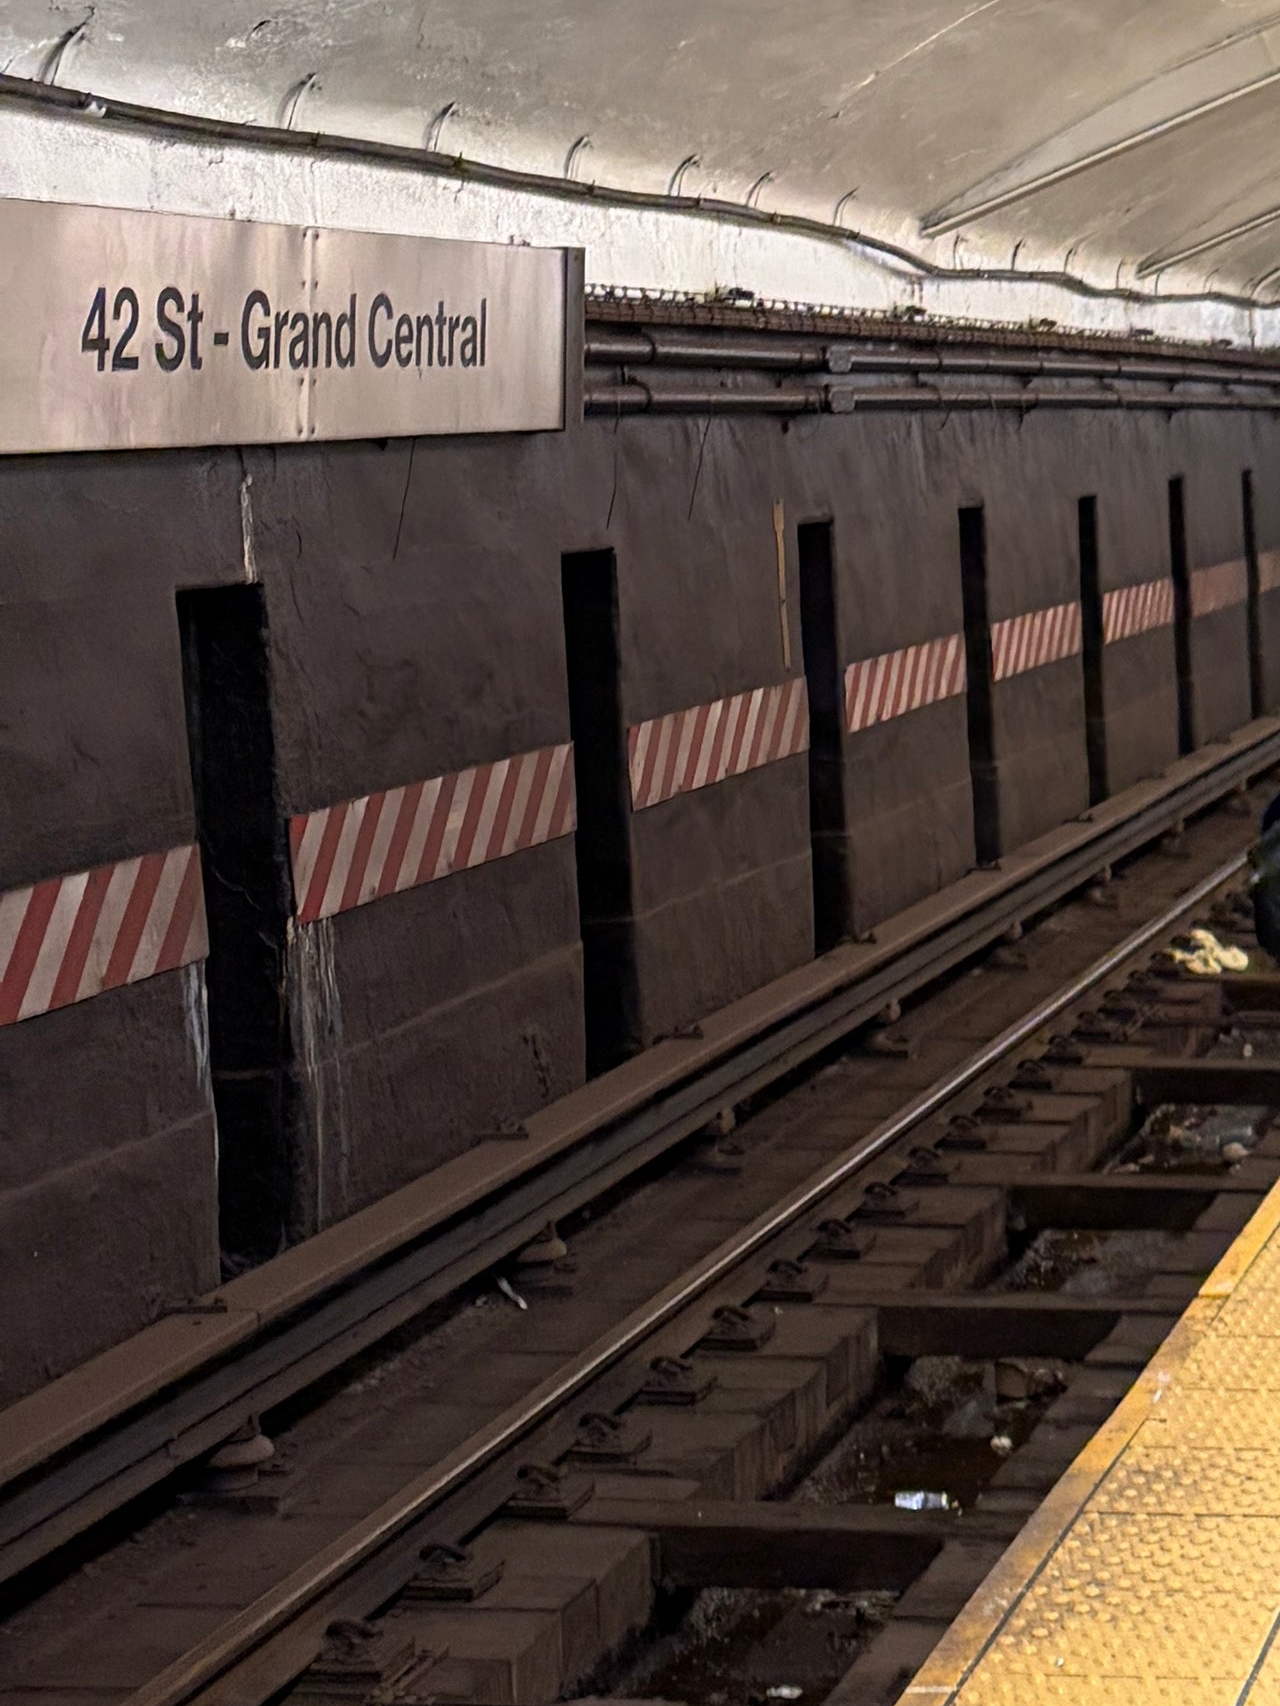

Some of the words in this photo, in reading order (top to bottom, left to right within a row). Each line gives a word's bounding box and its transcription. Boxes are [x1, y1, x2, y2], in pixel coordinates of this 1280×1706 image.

[81, 286, 139, 372] 42
[154, 286, 204, 372] St
[241, 289, 357, 370] Grand
[368, 292, 487, 369] Central
